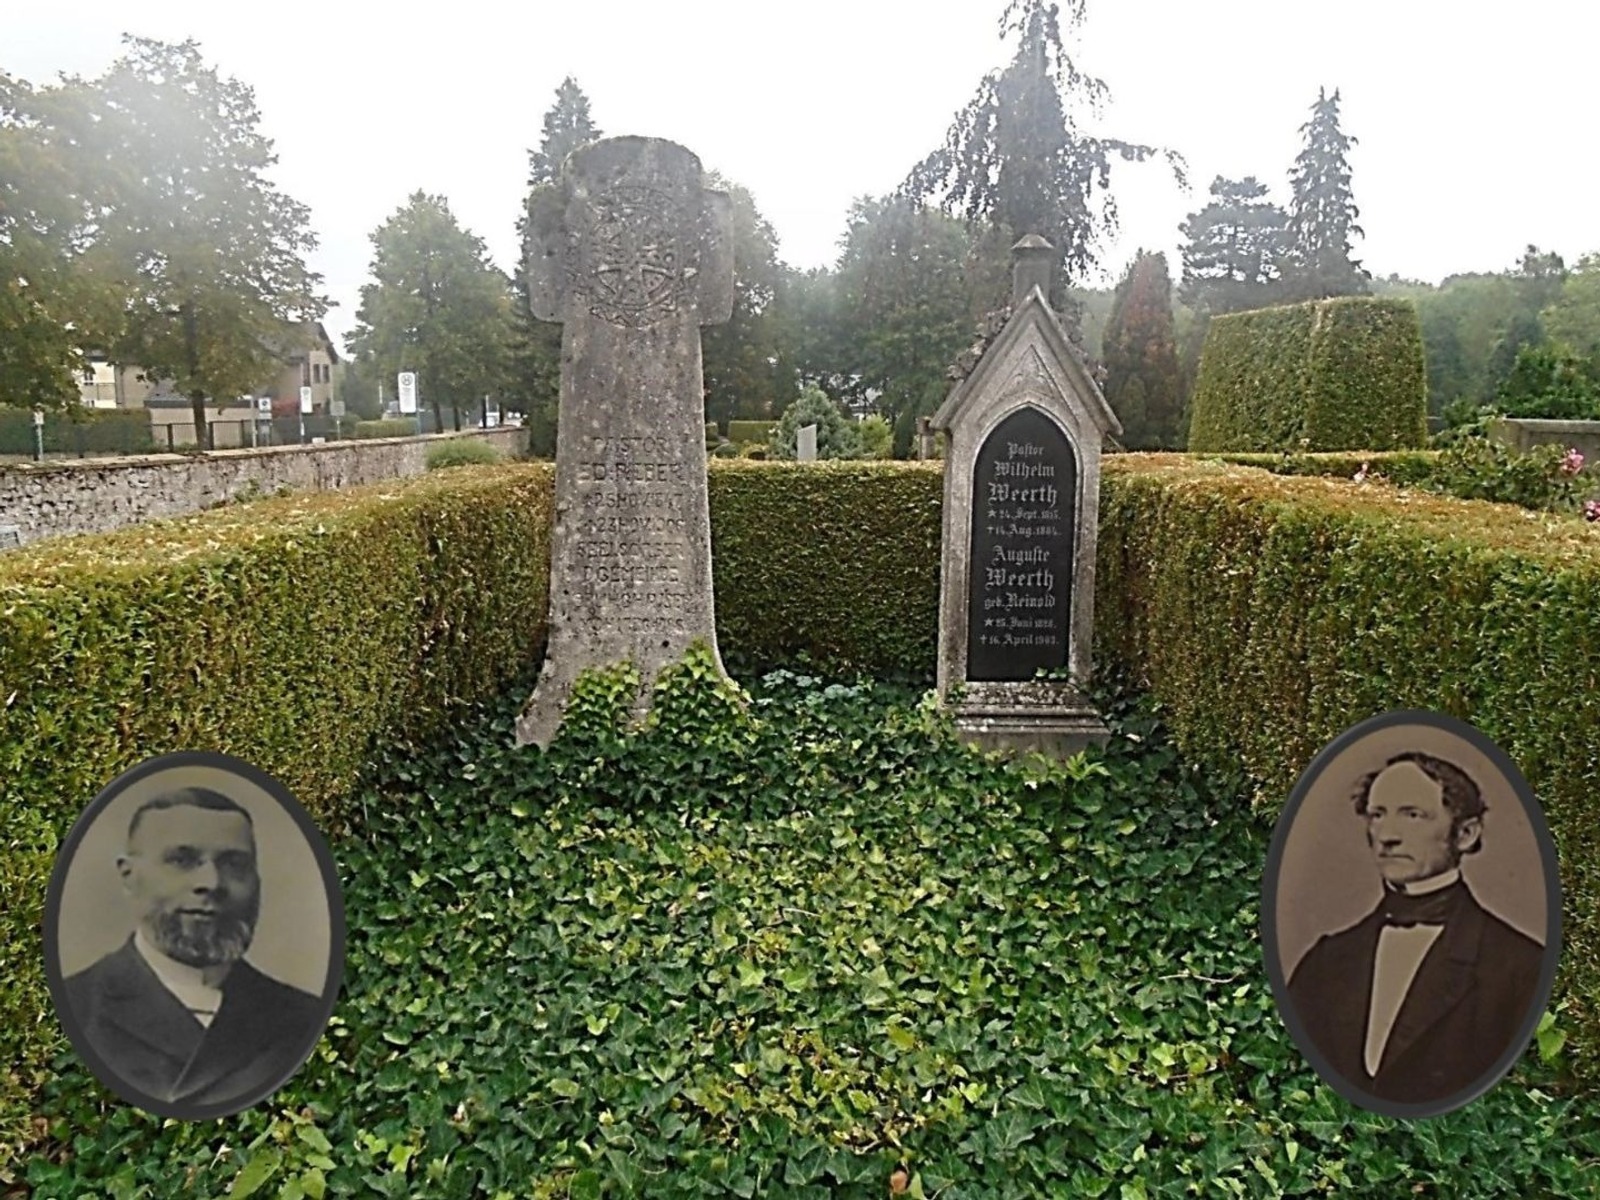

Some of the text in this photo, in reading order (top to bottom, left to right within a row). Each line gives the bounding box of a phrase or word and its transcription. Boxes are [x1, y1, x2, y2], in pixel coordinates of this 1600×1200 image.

[994, 461, 1055, 480] Wilhelm
[988, 482, 1057, 508] Weerth
[985, 567, 1053, 591] Weerth
[1002, 633, 1033, 646] April
